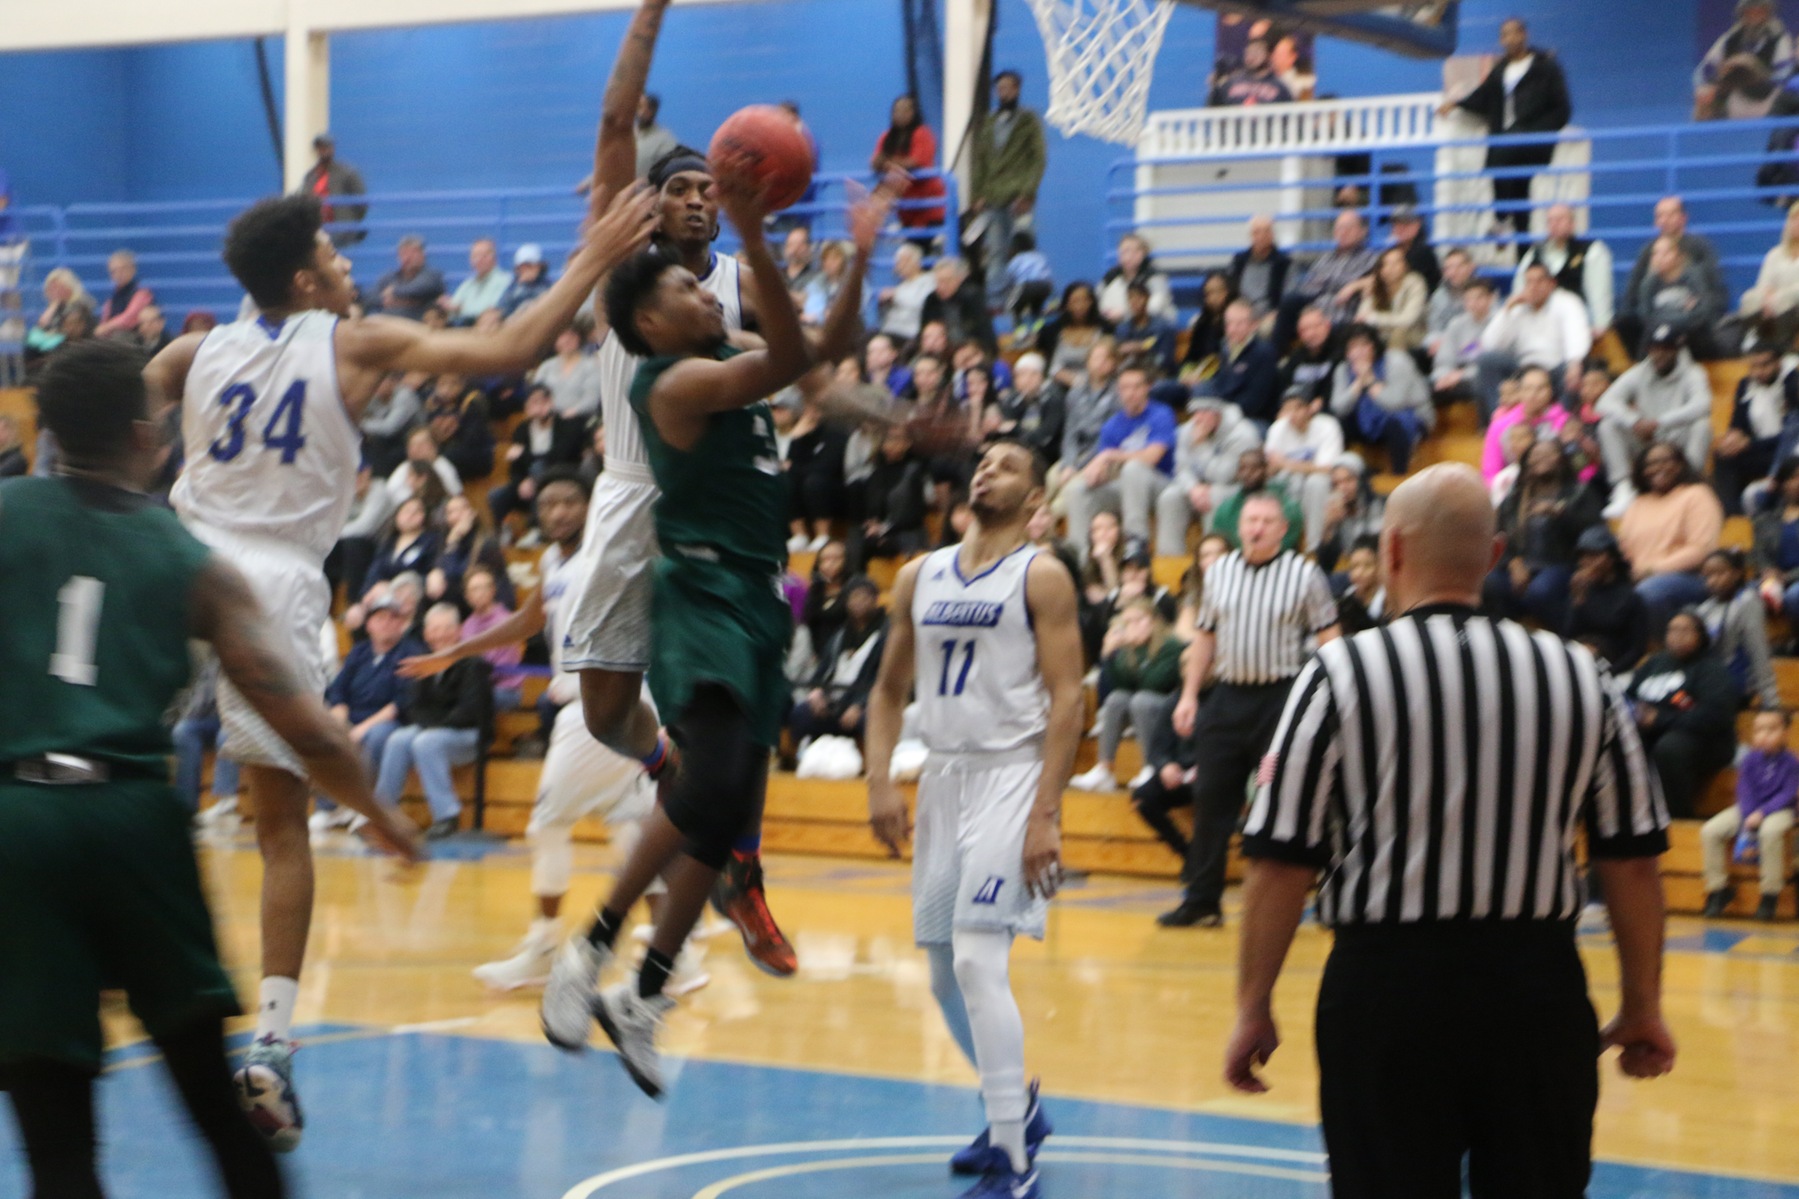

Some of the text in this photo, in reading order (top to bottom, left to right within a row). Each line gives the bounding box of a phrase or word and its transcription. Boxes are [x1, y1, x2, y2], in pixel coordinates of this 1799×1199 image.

[208, 379, 307, 464] 34
[48, 574, 106, 687] 1
[922, 600, 1003, 628] ALBERTUS
[937, 638, 976, 696] 11
